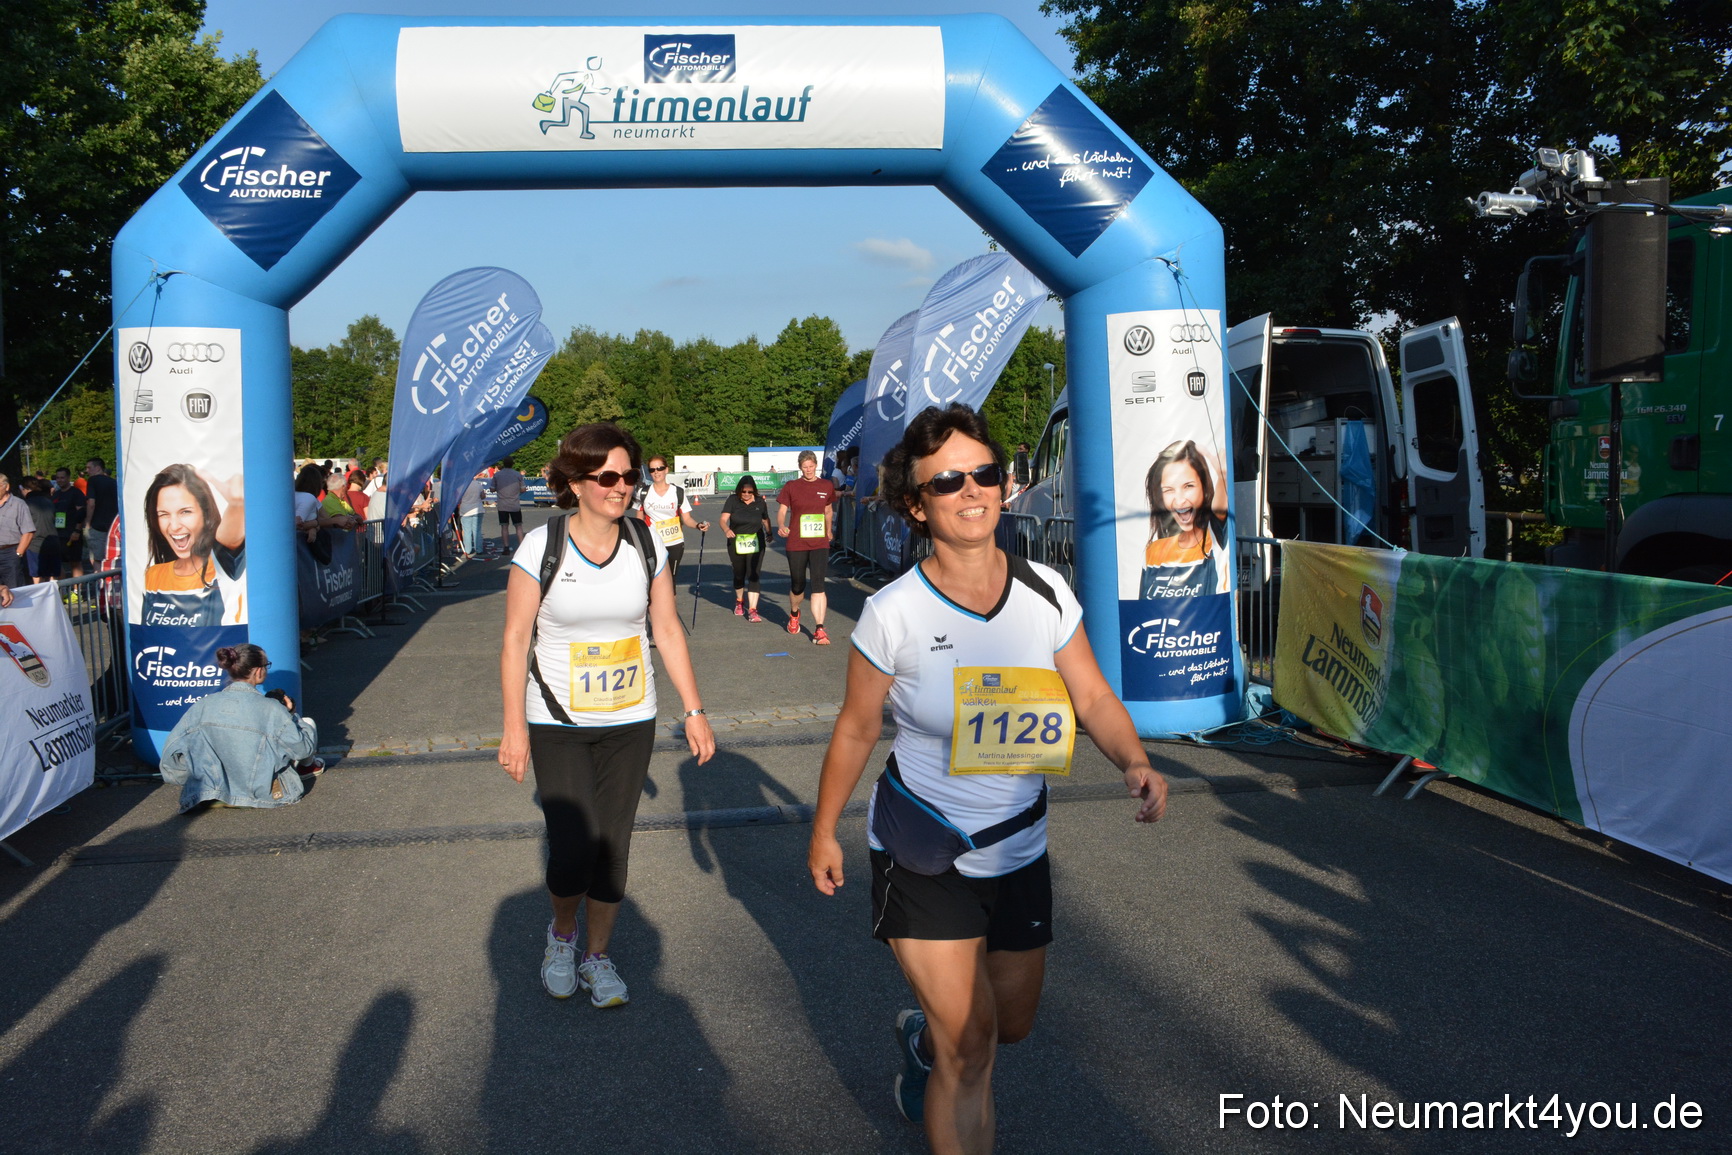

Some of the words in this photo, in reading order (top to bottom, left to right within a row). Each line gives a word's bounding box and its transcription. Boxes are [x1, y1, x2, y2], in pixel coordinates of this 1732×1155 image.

[663, 49, 730, 66] Fischer
[612, 85, 814, 122] firmenlauf
[613, 125, 695, 139] neumarkt
[1022, 154, 1050, 171] und
[220, 164, 331, 187] Fischer
[229, 188, 323, 199] AUTOMOBILE
[942, 275, 1016, 385] Fischer
[969, 293, 1026, 382] AUTOMOBILE
[430, 292, 511, 397] Fischer
[457, 312, 520, 396] AUTOMOBILE
[169, 367, 193, 375] Audi
[1189, 376, 1205, 391] FIAT
[189, 397, 210, 413] FIAT
[1124, 396, 1165, 405] SEAT
[129, 416, 162, 424] SEAT
[1713, 413, 1725, 431] 7
[1590, 461, 1609, 469] Neuma
[660, 525, 679, 537] 1609
[803, 522, 823, 531] 1122
[1146, 630, 1222, 649] Fischer
[930, 643, 954, 652] erima
[1154, 646, 1217, 658] AUTOMOBILE
[153, 679, 221, 688] AUTOMOBILE
[579, 665, 638, 693] 1127
[974, 685, 1018, 694] firmenlauf
[961, 697, 997, 706] walken
[25, 692, 86, 731] Neumarkter
[967, 711, 1063, 745] 1128
[1006, 752, 1043, 760] Messinger
